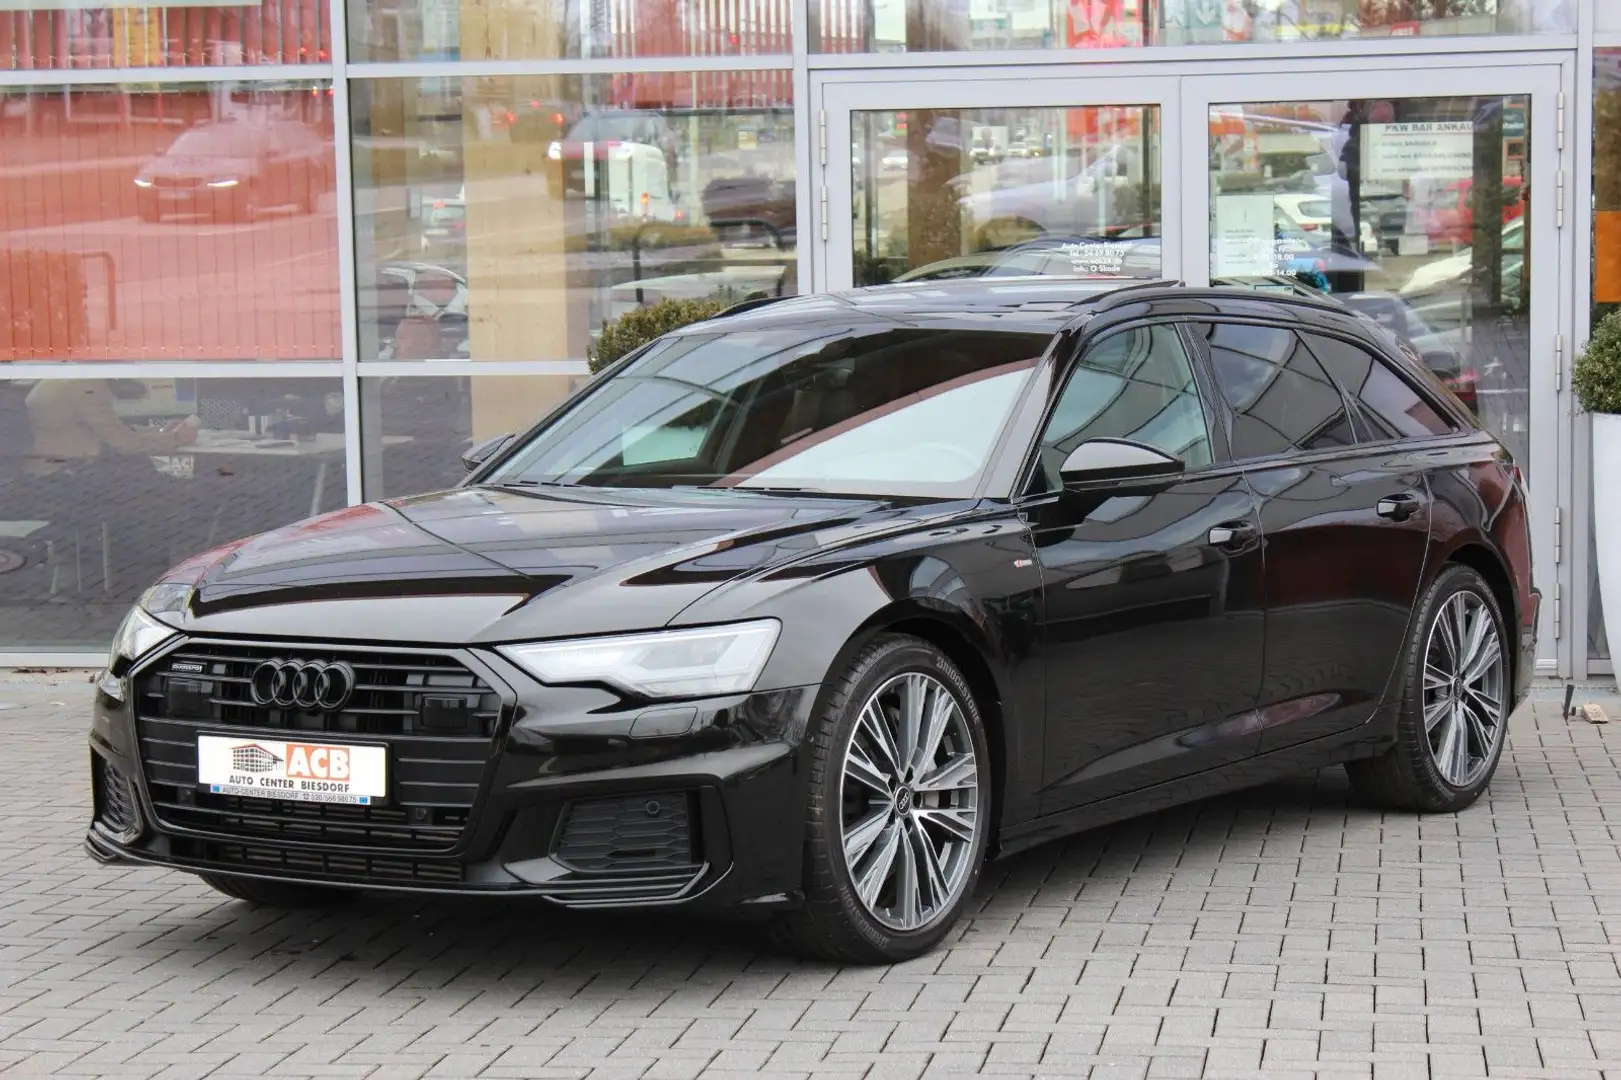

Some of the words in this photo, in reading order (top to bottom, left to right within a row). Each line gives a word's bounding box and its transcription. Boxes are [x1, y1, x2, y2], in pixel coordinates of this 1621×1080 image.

[1385, 124, 1408, 132] PKW
[1412, 124, 1432, 132] BAR
[936, 656, 981, 724] BRIDGESTONE
[288, 746, 349, 780] ACB
[229, 775, 254, 785] AUTO
[260, 778, 294, 789] CENTER
[301, 780, 350, 792] BIESDORF
